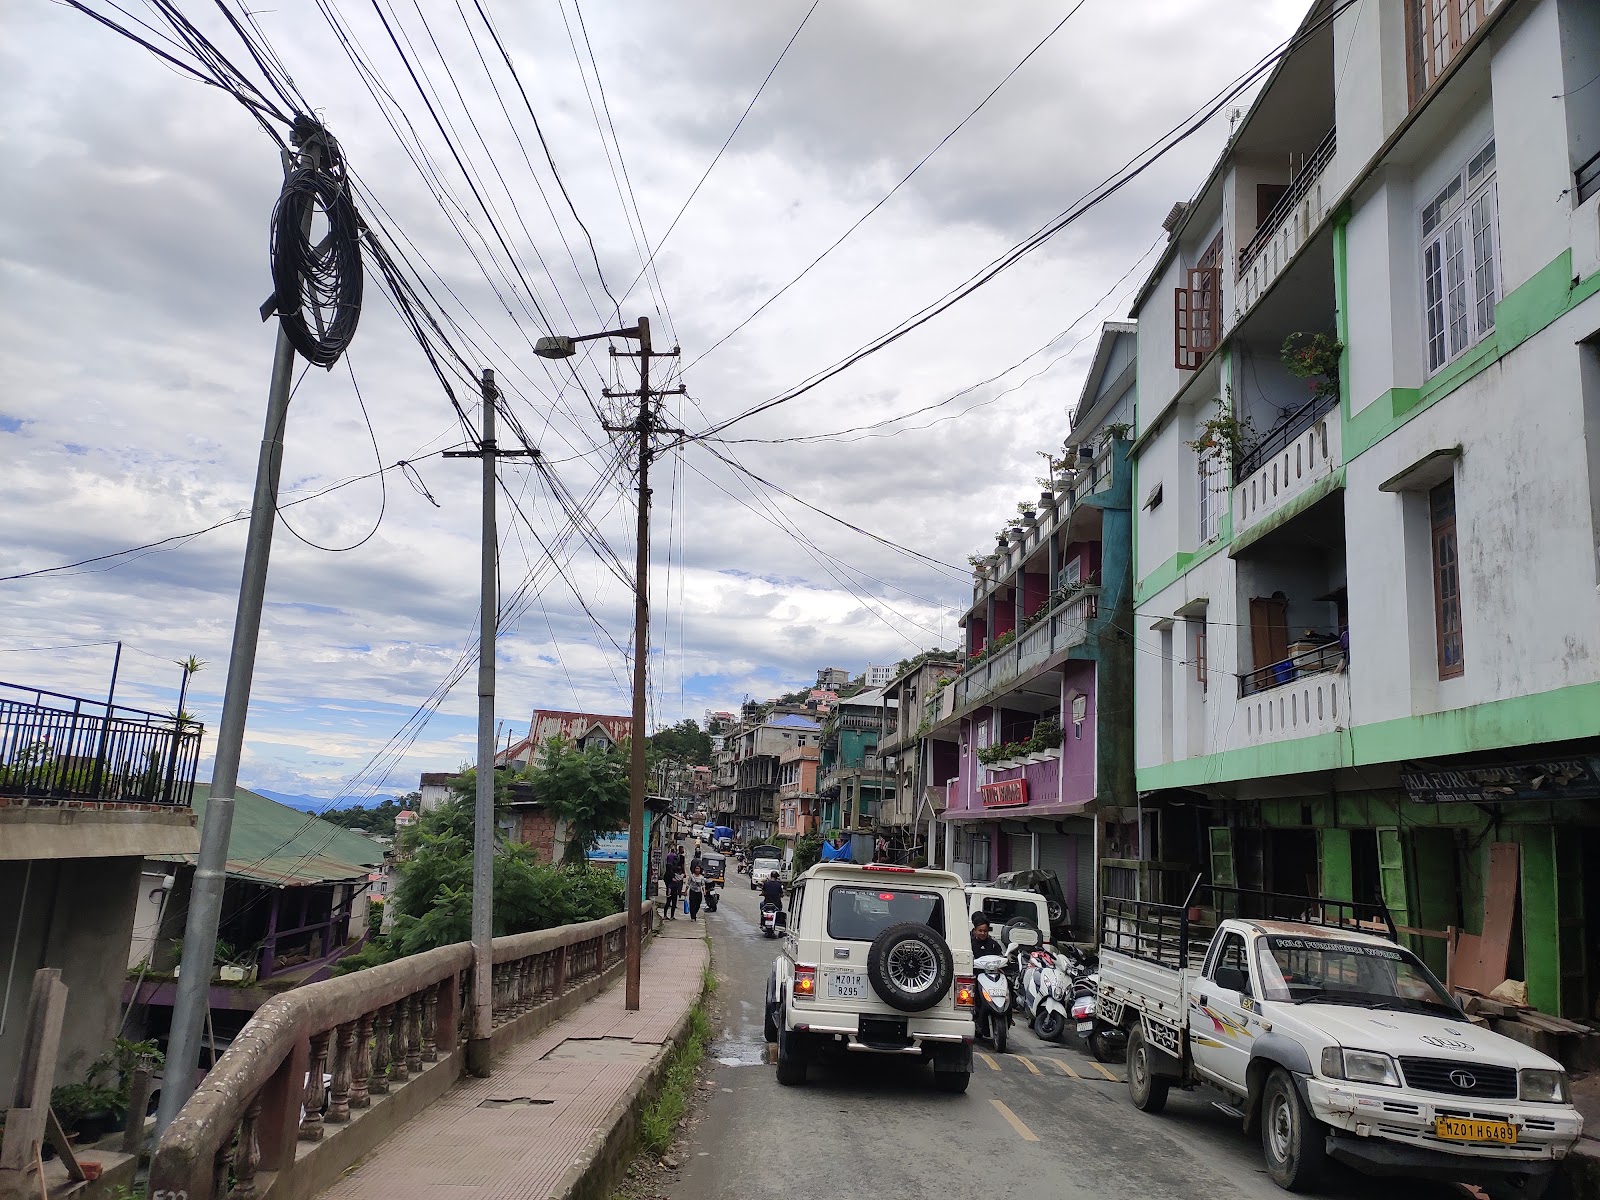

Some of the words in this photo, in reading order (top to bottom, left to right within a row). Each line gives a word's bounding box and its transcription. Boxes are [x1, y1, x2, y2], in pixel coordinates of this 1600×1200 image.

[835, 975, 861, 985] MZ01R
[838, 986, 858, 996] 8295
[1242, 998, 1253, 1009] EX
